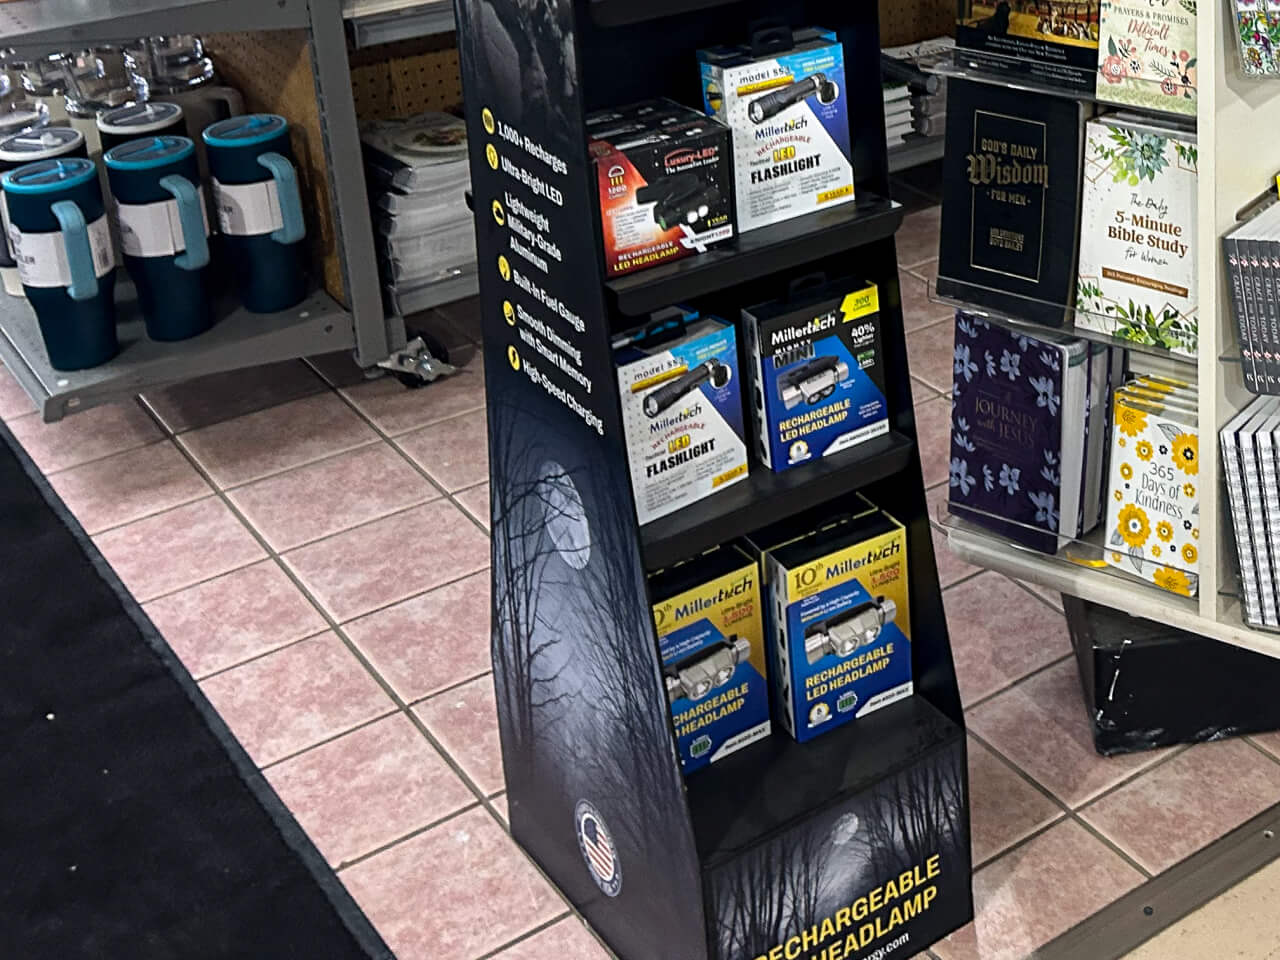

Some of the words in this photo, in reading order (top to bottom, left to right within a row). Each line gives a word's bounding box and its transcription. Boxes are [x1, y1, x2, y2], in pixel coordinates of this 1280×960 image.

[1113, 5, 1145, 21] PRAYERS
[1152, 12, 1190, 26] PROMISES
[1126, 18, 1171, 39] Difficult
[1142, 39, 1170, 58] Times
[738, 72, 770, 86] model
[497, 120, 524, 150] 1,000+
[524, 134, 569, 176] Recharges
[981, 138, 1009, 155] GOD'S
[1010, 144, 1038, 161] DAILY
[500, 154, 545, 197] Ultra-Bright
[750, 153, 822, 185] FLASHLIGHT
[966, 153, 1050, 189] Wisdom
[503, 191, 550, 234] Lightweight
[1129, 192, 1144, 208] The
[1145, 196, 1170, 218] Daily
[507, 212, 563, 262] Military-Grade
[1114, 209, 1183, 238] 5-Minute
[509, 235, 550, 274] Aluminum
[1107, 225, 1145, 245] Bible
[1145, 233, 1189, 259] Study
[512, 267, 541, 299] Built-In
[540, 287, 559, 314] Fuel
[558, 302, 587, 333] Gauge
[516, 304, 547, 339] Smooth
[546, 327, 584, 367] Dimming
[850, 321, 876, 340] 40%
[519, 327, 537, 350] with
[536, 336, 560, 368] Smart
[559, 356, 593, 394] Memory
[633, 365, 665, 382] model
[773, 345, 817, 370] MINI
[521, 358, 568, 406] High-Speed
[566, 390, 605, 436] Charging
[974, 395, 1038, 432] JOURNEY
[645, 437, 717, 479] FLASHLIGHT
[1148, 460, 1175, 483] 365
[1140, 471, 1169, 497] Days
[1168, 483, 1183, 502] of
[1133, 488, 1185, 521] Kindness
